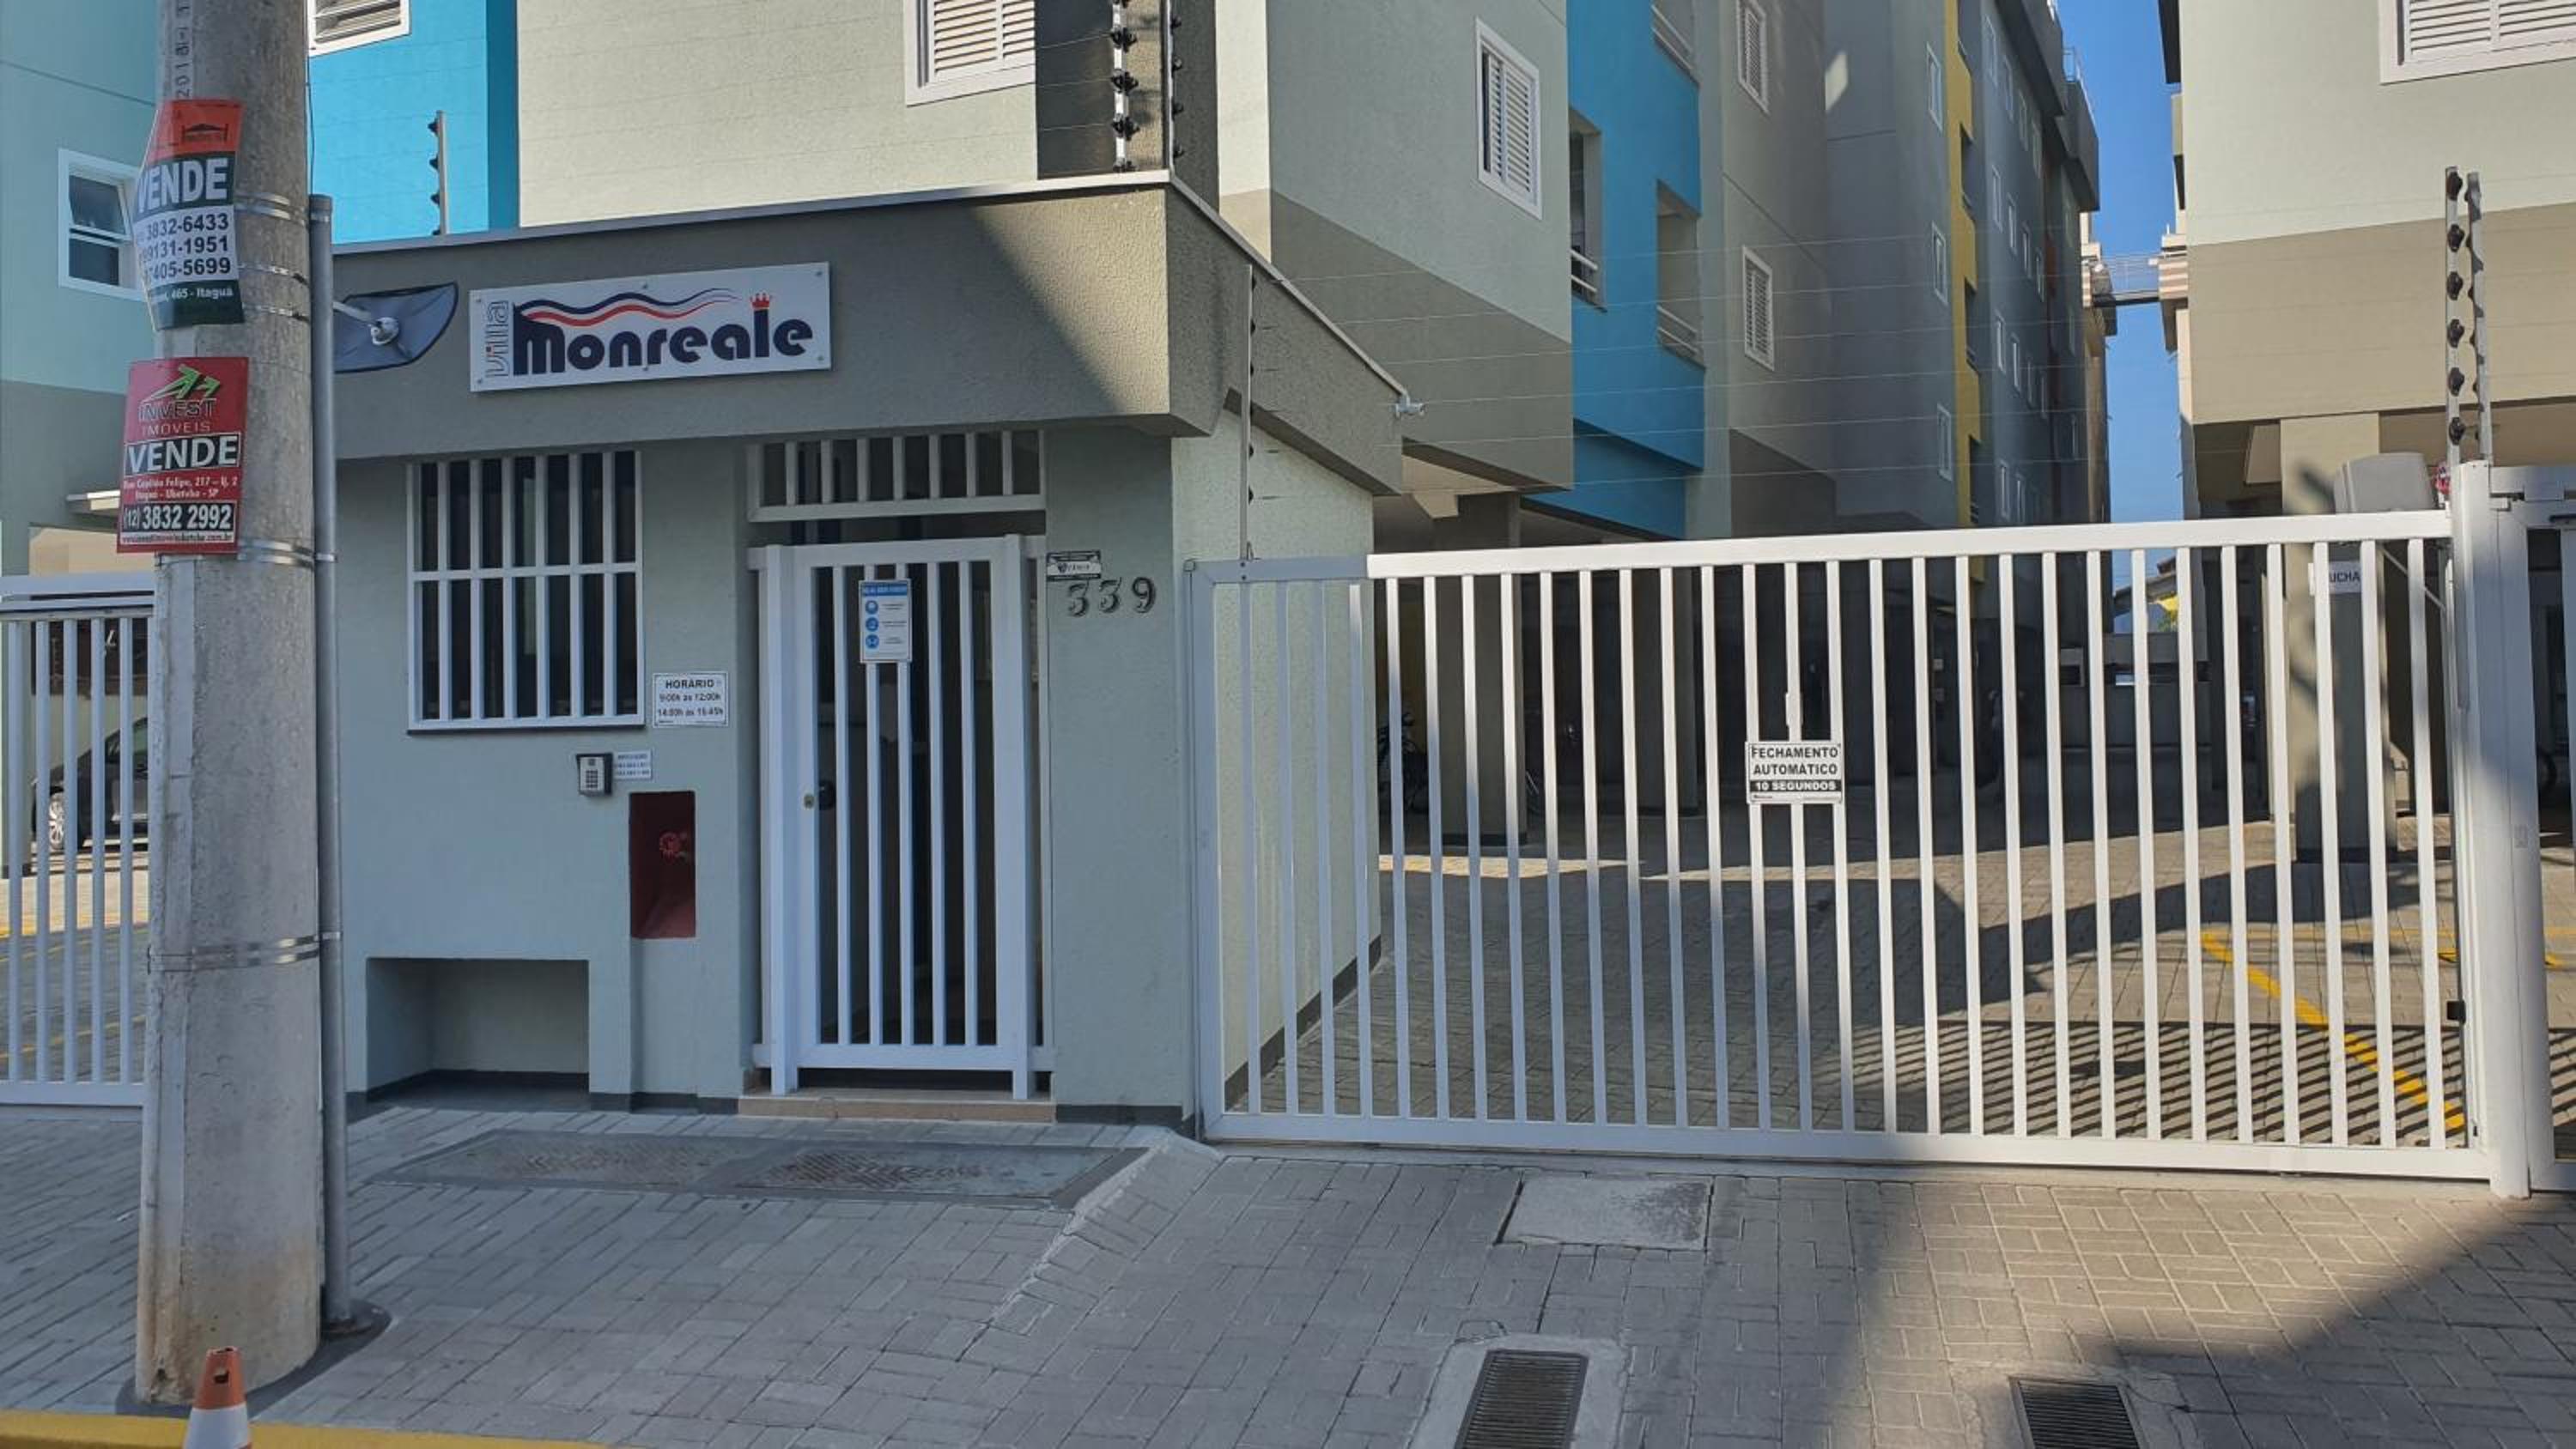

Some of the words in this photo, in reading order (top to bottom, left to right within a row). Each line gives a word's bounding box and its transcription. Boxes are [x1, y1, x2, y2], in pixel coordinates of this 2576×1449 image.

[137, 157, 228, 213] VENDE
[485, 300, 509, 378] villa
[129, 436, 238, 473] VENDE
[124, 507, 140, 530] (12)
[142, 504, 183, 530] 3832
[186, 504, 232, 530] 2992
[2329, 571, 2360, 583] UCHA
[1067, 577, 1156, 617] 339
[1752, 747, 1838, 758] FECHAMENTO
[1758, 780, 1770, 791] 10
[1771, 780, 1837, 791] SEGUNDOS
